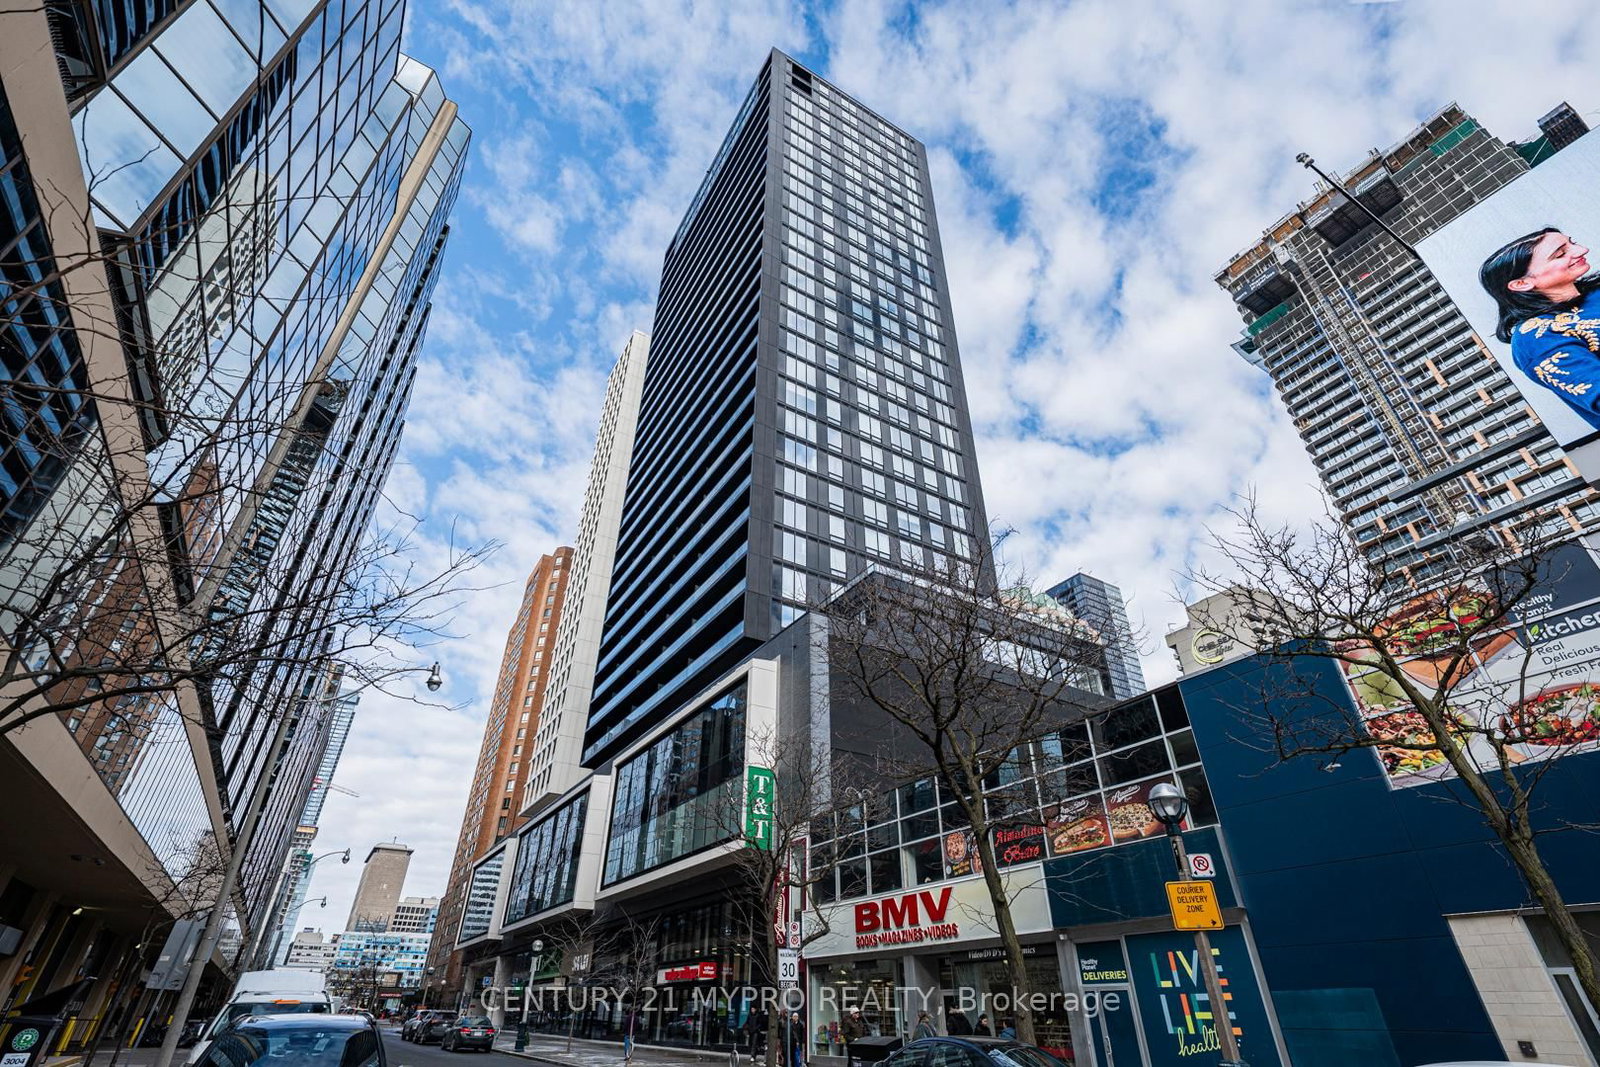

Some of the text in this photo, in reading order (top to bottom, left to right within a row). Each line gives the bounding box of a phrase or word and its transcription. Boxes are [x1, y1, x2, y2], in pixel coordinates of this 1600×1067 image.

[1514, 603, 1553, 620] Panet
[1537, 641, 1565, 656] Real
[1542, 645, 1600, 665] Delicious
[1550, 663, 1588, 679] Fresh
[752, 774, 771, 839] T&T
[1177, 886, 1205, 894] COURIER
[1177, 895, 1208, 904] DELIVERY
[855, 886, 953, 934] BMV
[1187, 904, 1205, 913] ZONE
[782, 962, 795, 978] 30
[1083, 970, 1127, 981] DELIVERIES
[4, 1057, 26, 1065] 3004
